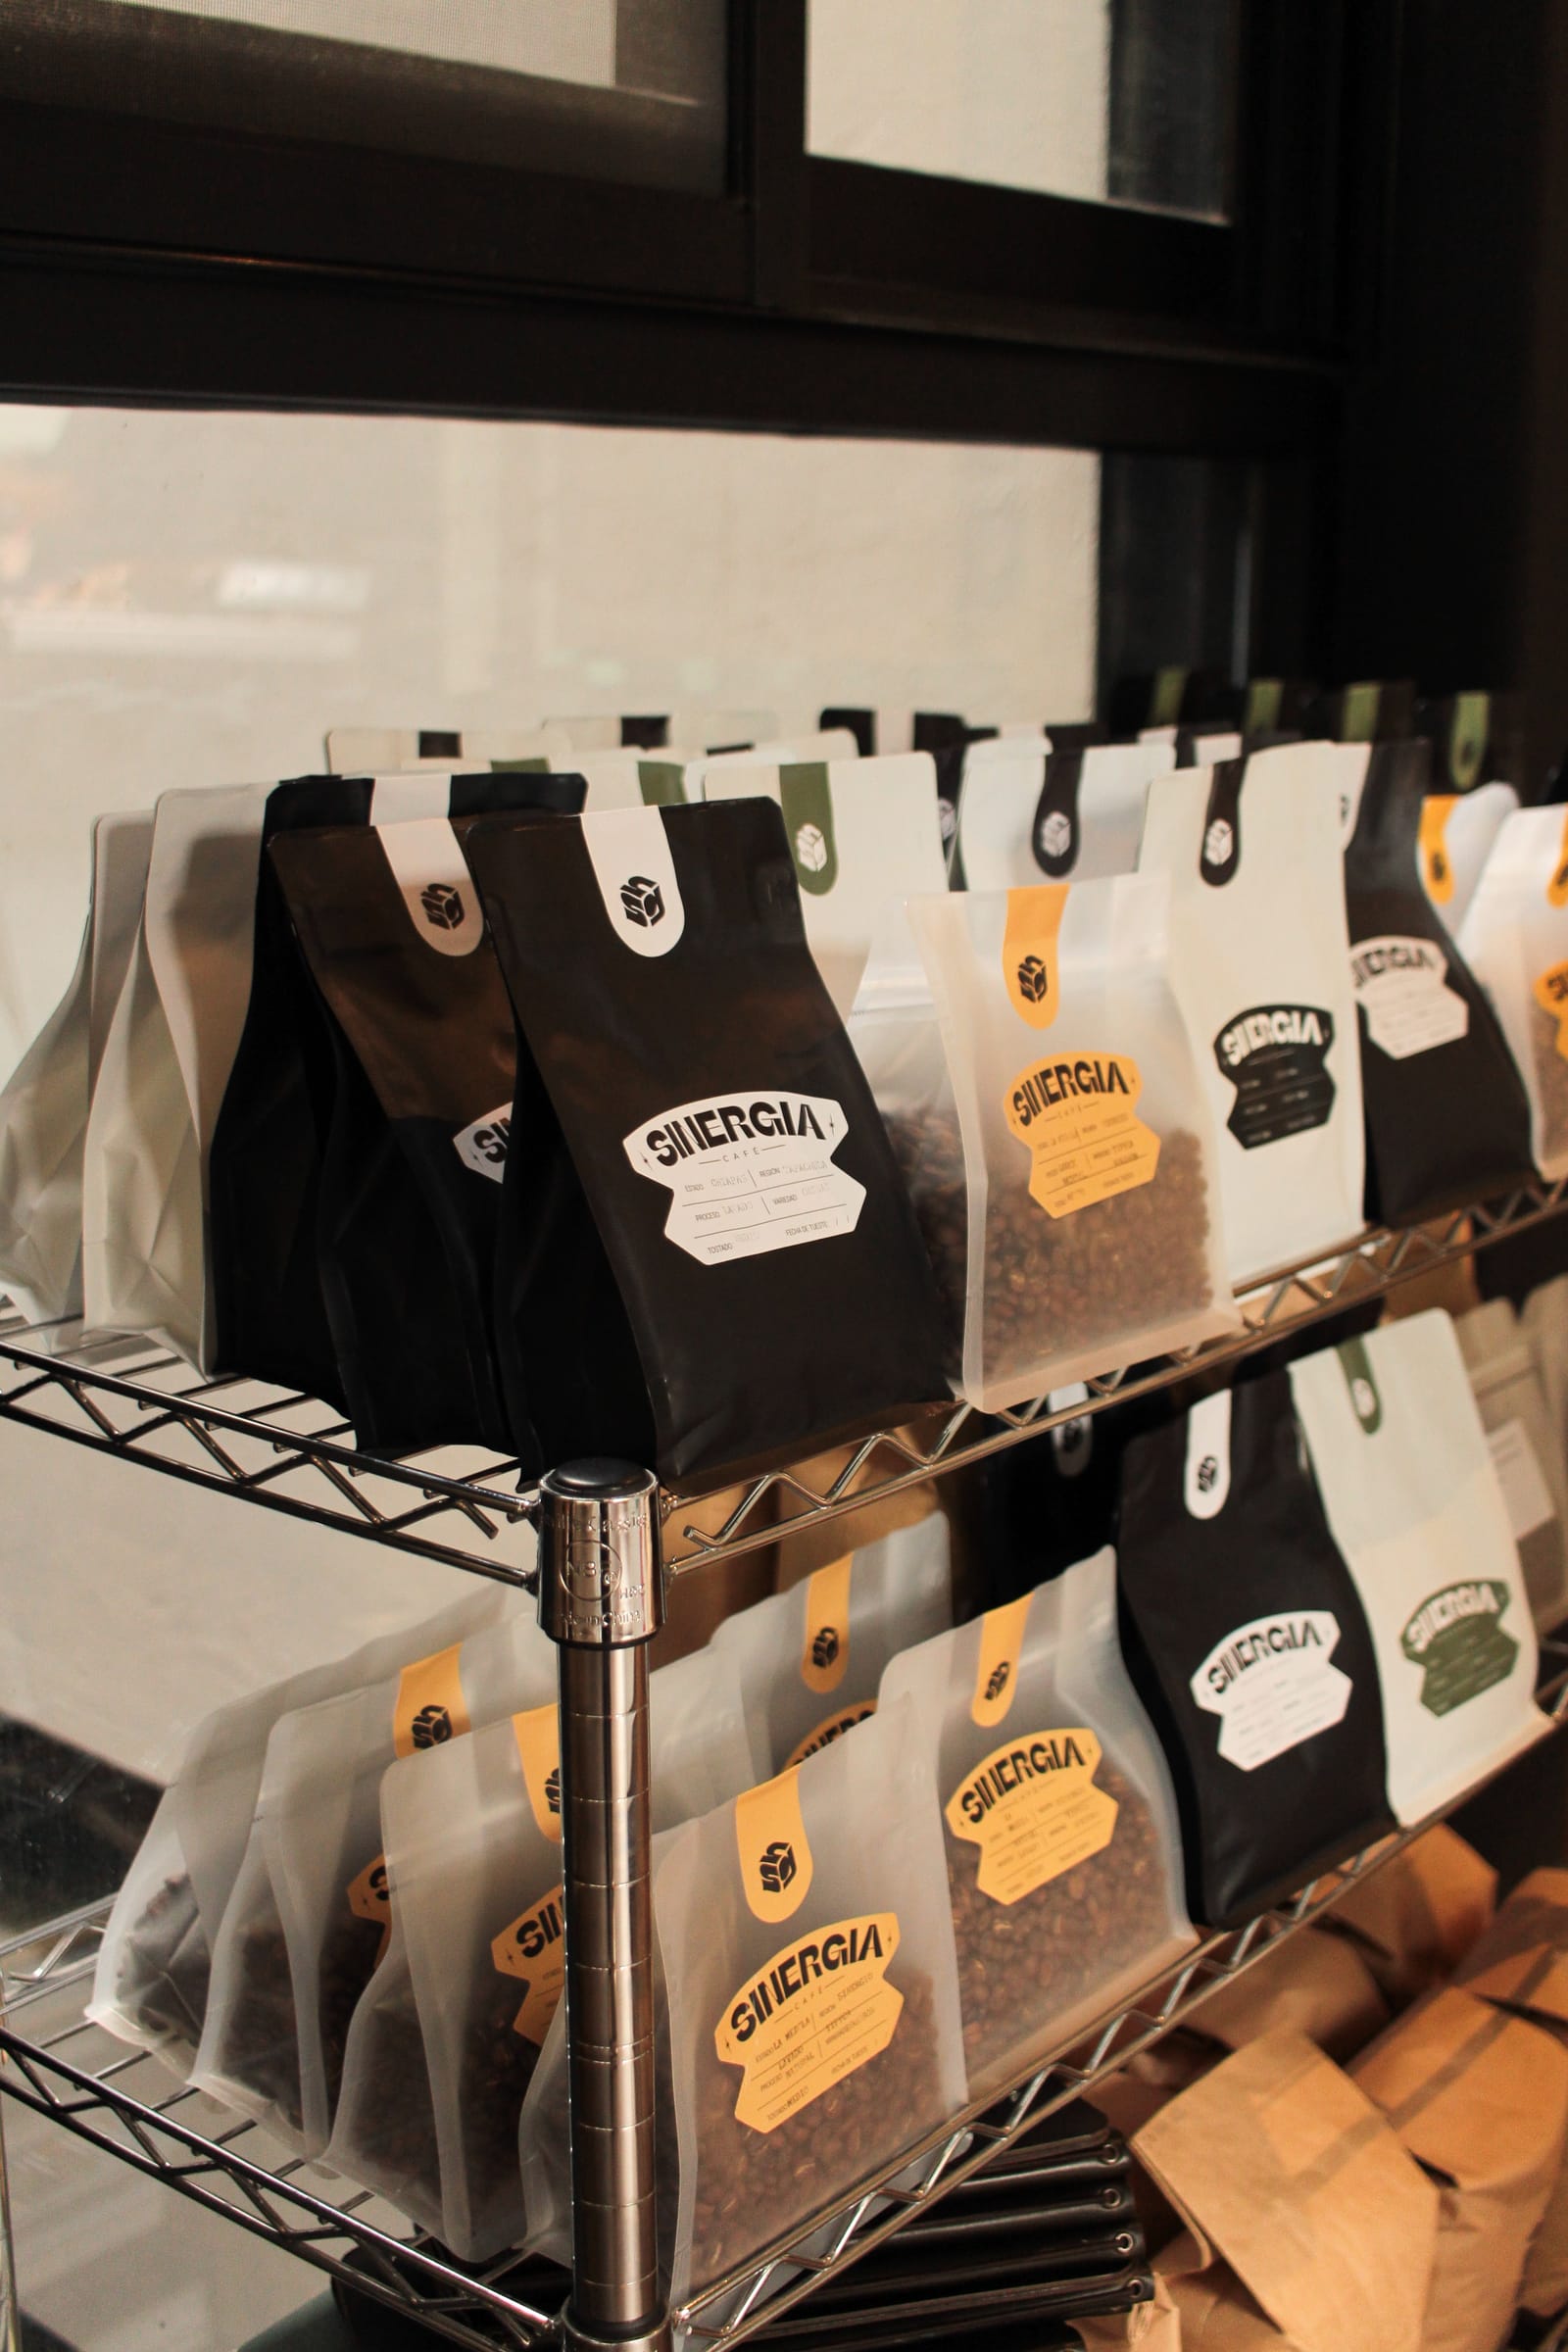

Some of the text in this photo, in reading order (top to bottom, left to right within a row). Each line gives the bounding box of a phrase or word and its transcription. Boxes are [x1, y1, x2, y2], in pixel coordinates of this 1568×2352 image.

[1012, 1059, 1130, 1126] SINERGIA
[646, 1102, 826, 1166] SINERGIA
[1207, 1620, 1323, 1694] SINERGIA
[961, 1737, 1087, 1824] SINERGIA
[730, 1923, 884, 2042] SINERGIA
